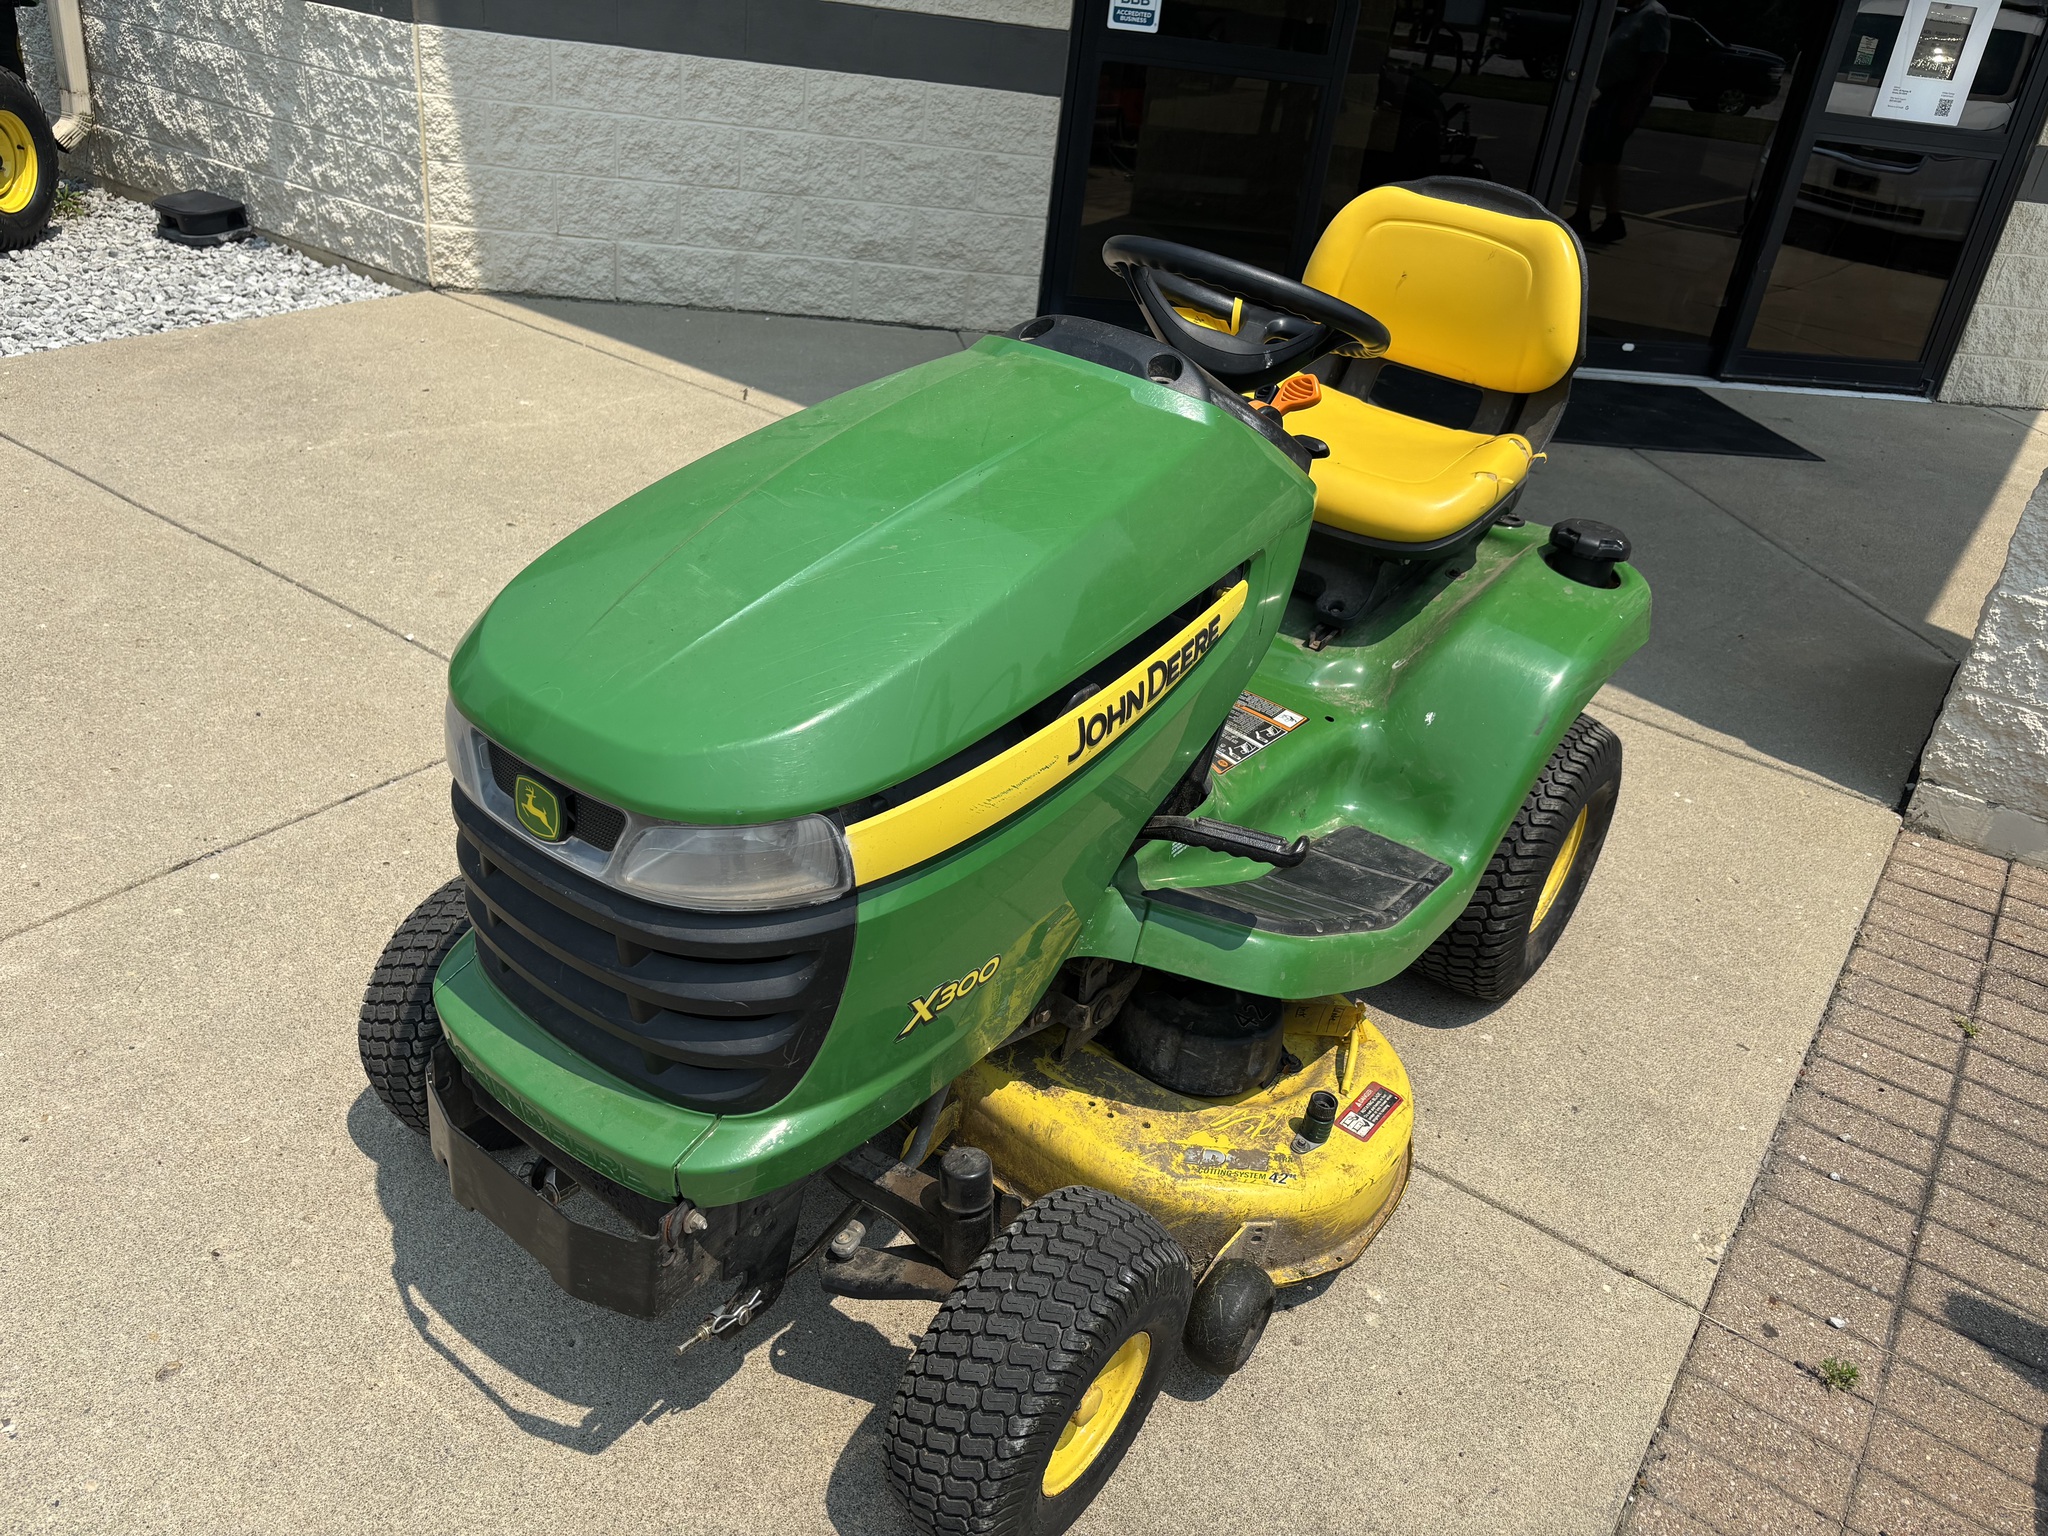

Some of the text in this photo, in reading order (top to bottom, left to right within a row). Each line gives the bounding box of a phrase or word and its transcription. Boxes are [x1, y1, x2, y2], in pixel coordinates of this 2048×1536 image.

[1116, 9, 1152, 18] ACCREDITED
[1119, 16, 1147, 24] BUSINESS
[1067, 614, 1221, 764] JOHN DEERE
[894, 954, 1001, 1042] X300
[1234, 1004, 1272, 1028] 42
[1233, 1171, 1267, 1180] SYSTEM
